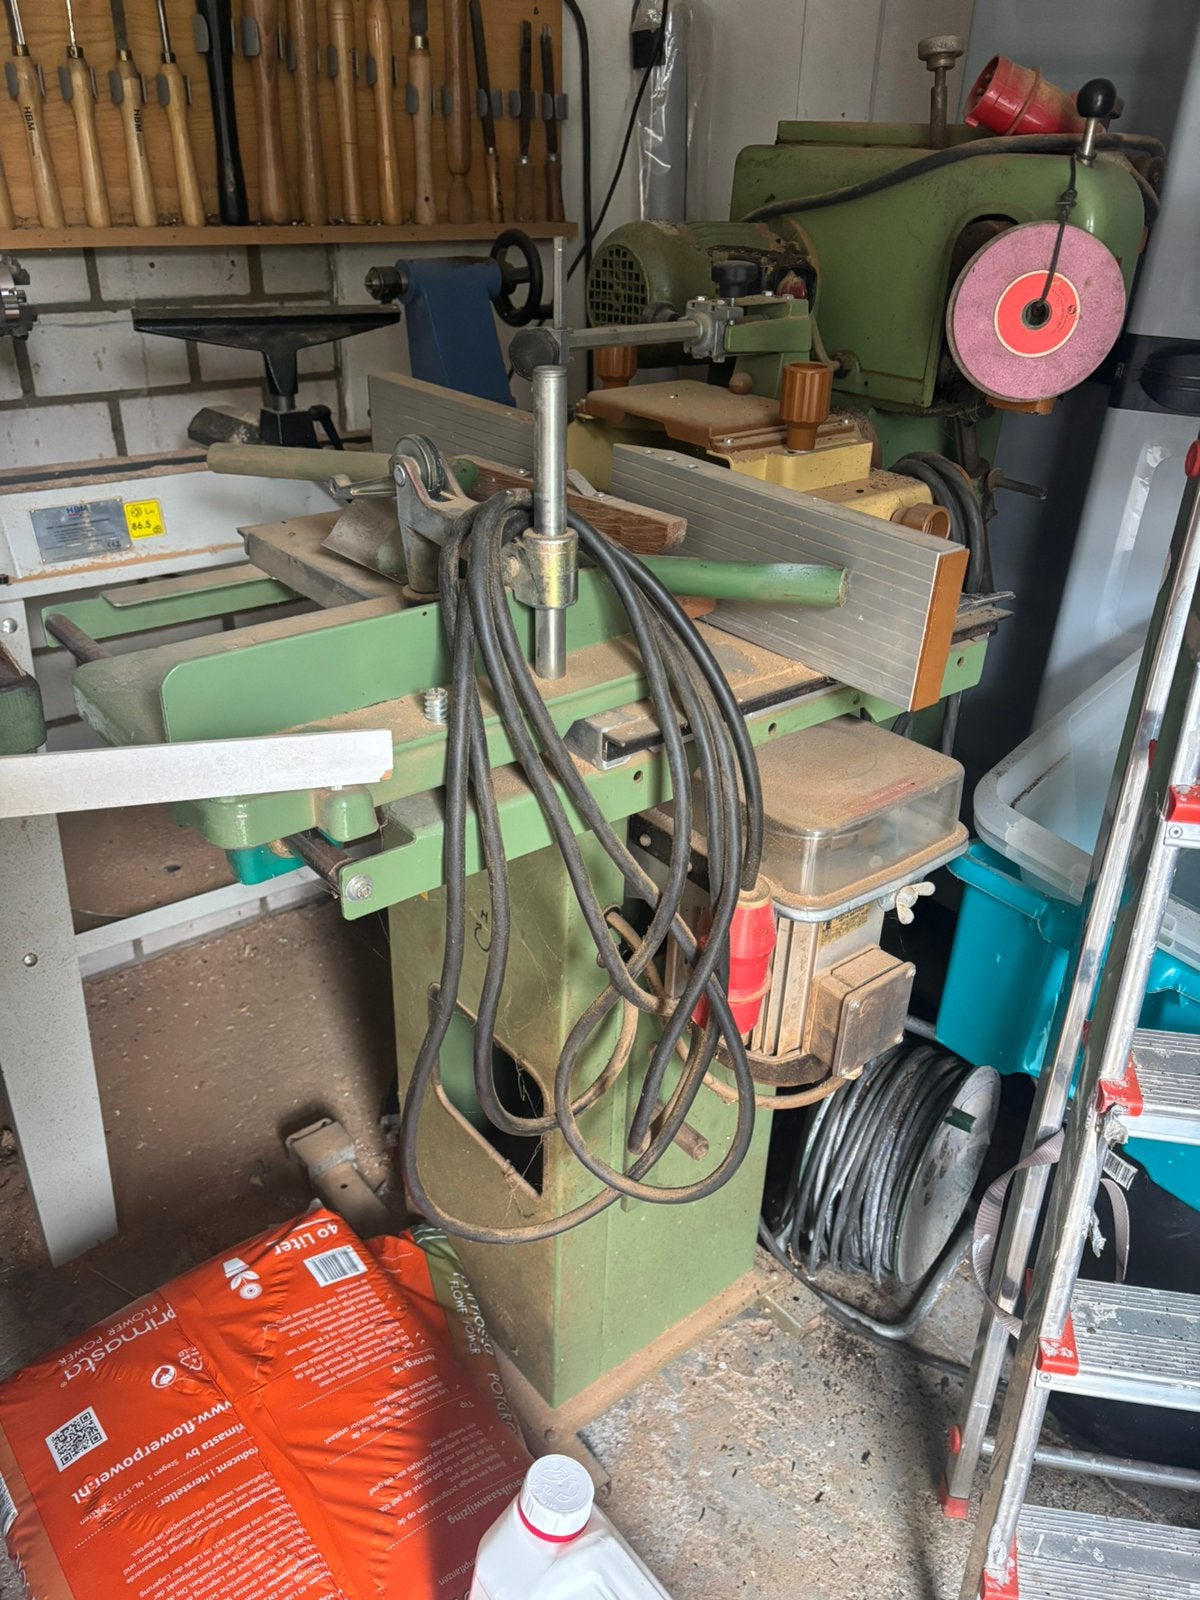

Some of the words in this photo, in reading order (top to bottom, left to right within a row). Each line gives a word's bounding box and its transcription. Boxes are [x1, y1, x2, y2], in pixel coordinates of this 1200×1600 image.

[23, 106, 34, 131] HBM
[133, 108, 142, 133] HBM
[66, 504, 88, 513] HBM
[132, 520, 151, 530] 86.5
[316, 1223, 337, 1238] 40
[274, 1233, 315, 1255] Liter
[107, 1304, 157, 1336] FLOWER
[58, 1336, 102, 1366] POWER
[303, 1367, 315, 1375] dat
[318, 1376, 337, 1387] water
[459, 1400, 474, 1408] Tip
[350, 1413, 378, 1429] Hierdoor
[350, 1431, 361, 1439] de
[185, 1447, 200, 1459] bv
[153, 1459, 179, 1476] Stegen
[395, 1469, 406, 1478] aan
[156, 1473, 209, 1507] Hersteller:
[368, 1482, 383, 1496] geef
[403, 1489, 412, 1497] de
[235, 1492, 248, 1503] und
[390, 1494, 403, 1506] pot
[203, 1500, 235, 1520] Umtopfen
[205, 1501, 215, 1510] für
[416, 1503, 428, 1513] aan
[164, 1507, 205, 1534] Pflanzungen
[250, 1515, 263, 1526] und
[396, 1517, 406, 1525] de
[406, 1511, 415, 1519] op
[191, 1519, 203, 1528] von
[154, 1532, 164, 1541] im
[226, 1523, 251, 1540] können
[237, 1525, 266, 1545] beziehen
[130, 1539, 155, 1556] Garten.
[212, 1537, 226, 1549] sich
[223, 1543, 236, 1555] sich
[137, 1545, 162, 1564] Balkon-
[202, 1547, 212, 1556] im
[211, 1551, 222, 1562] auf
[231, 1547, 248, 1561] dicht
[183, 1553, 203, 1567] Laufe
[197, 1559, 211, 1570] den
[252, 1554, 276, 1572] können
[122, 1562, 136, 1575] und
[126, 1552, 169, 1583] Pflanzenerde
[171, 1565, 183, 1575] der
[225, 1567, 237, 1577] der
[165, 1568, 198, 1591] Zeitpunkt
[258, 1567, 276, 1581] Nicht
[139, 1573, 171, 1597] Lagerung
[193, 1575, 225, 1596] Lagerung
[219, 1570, 252, 1593] natürliche
[233, 1578, 258, 1597] direkter
[277, 1580, 294, 1593] nach
[154, 1588, 165, 1600] der
[175, 1586, 188, 1596] Die
[297, 1585, 306, 1593] 40
